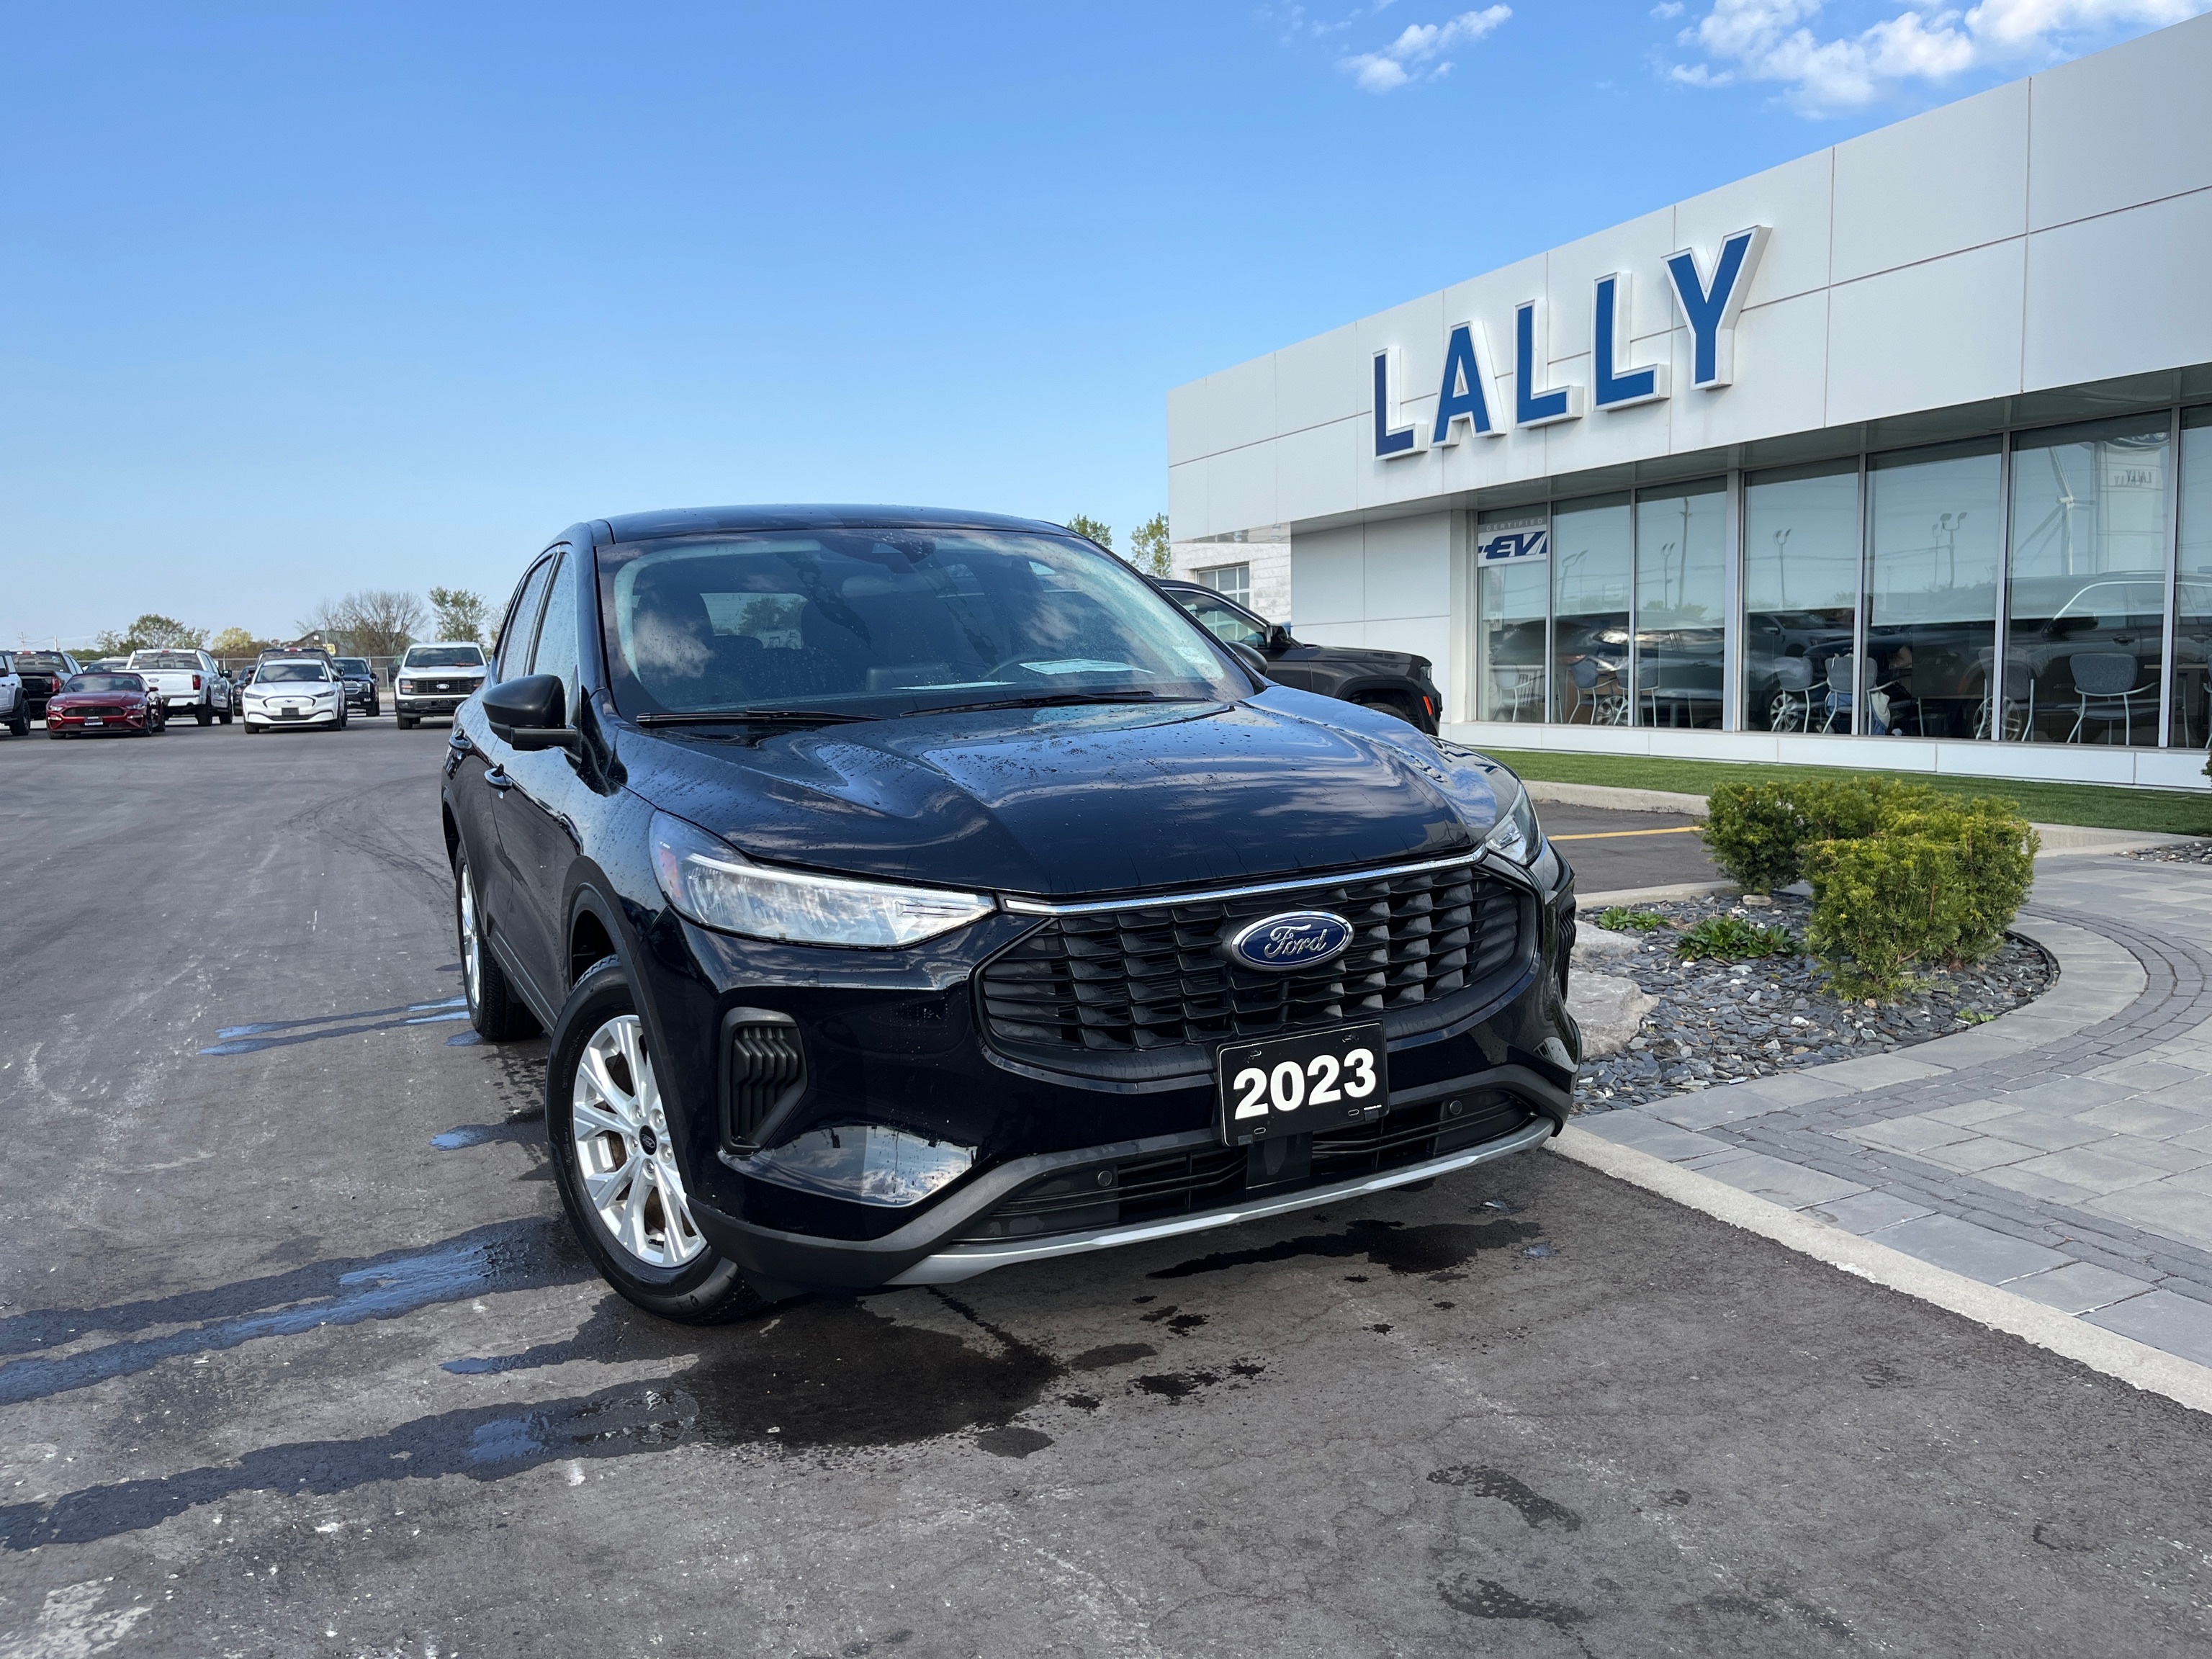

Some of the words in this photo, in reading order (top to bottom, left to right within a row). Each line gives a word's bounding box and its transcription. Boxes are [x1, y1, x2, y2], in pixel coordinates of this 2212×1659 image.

[1372, 225, 1761, 461] LALLY
[1486, 518, 1543, 531] CERTIFIED
[1264, 923, 1328, 958] Ford
[1233, 1048, 1377, 1120] 2023
